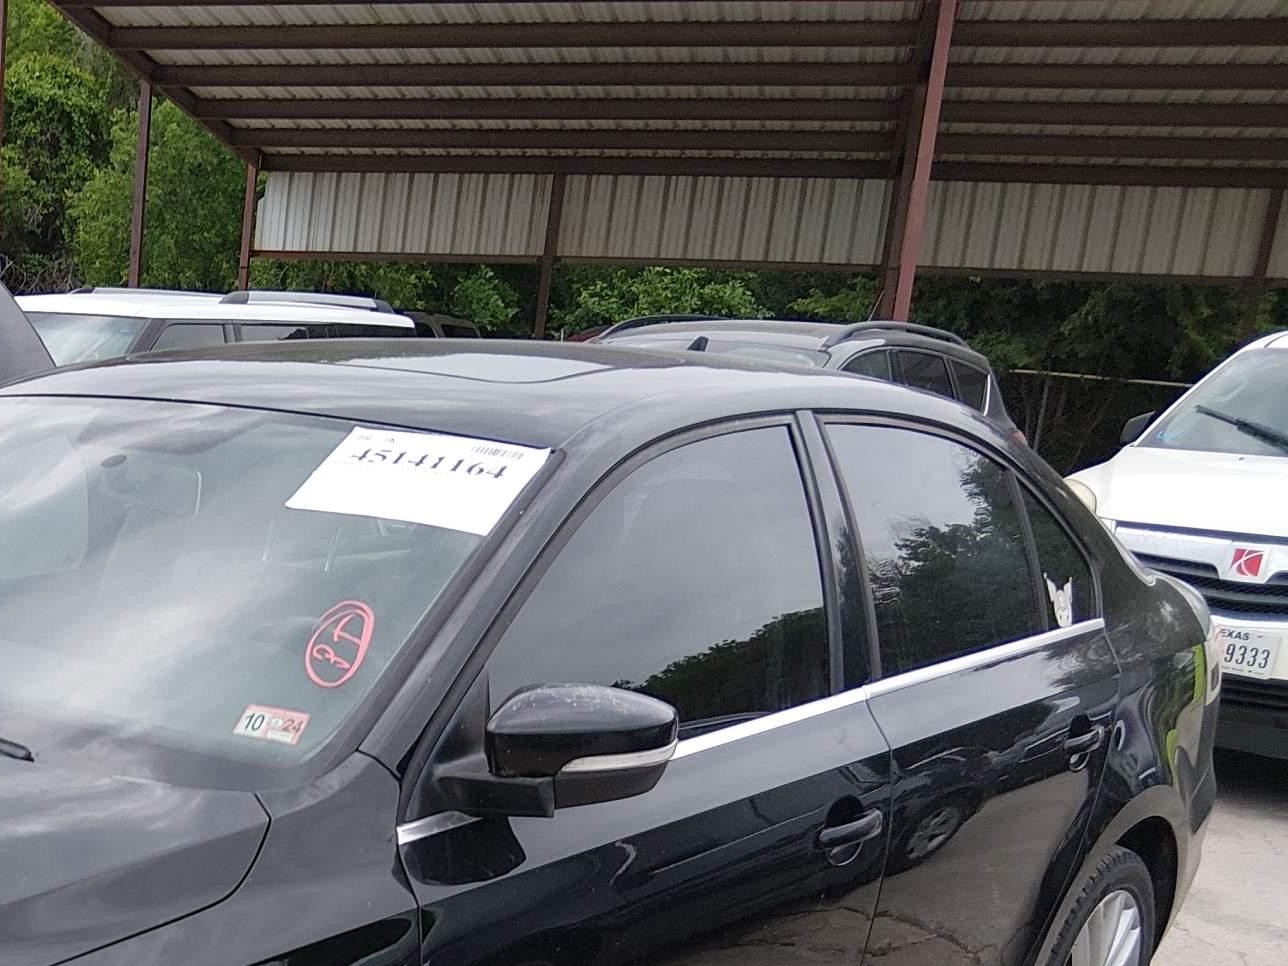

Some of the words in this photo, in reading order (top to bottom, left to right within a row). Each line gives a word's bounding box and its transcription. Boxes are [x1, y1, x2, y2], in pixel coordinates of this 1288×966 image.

[351, 448, 508, 479] 45141164
[1219, 628, 1250, 641] EXAS
[1223, 643, 1271, 669] 9333
[244, 713, 265, 731] 10
[283, 718, 304, 733] 24
